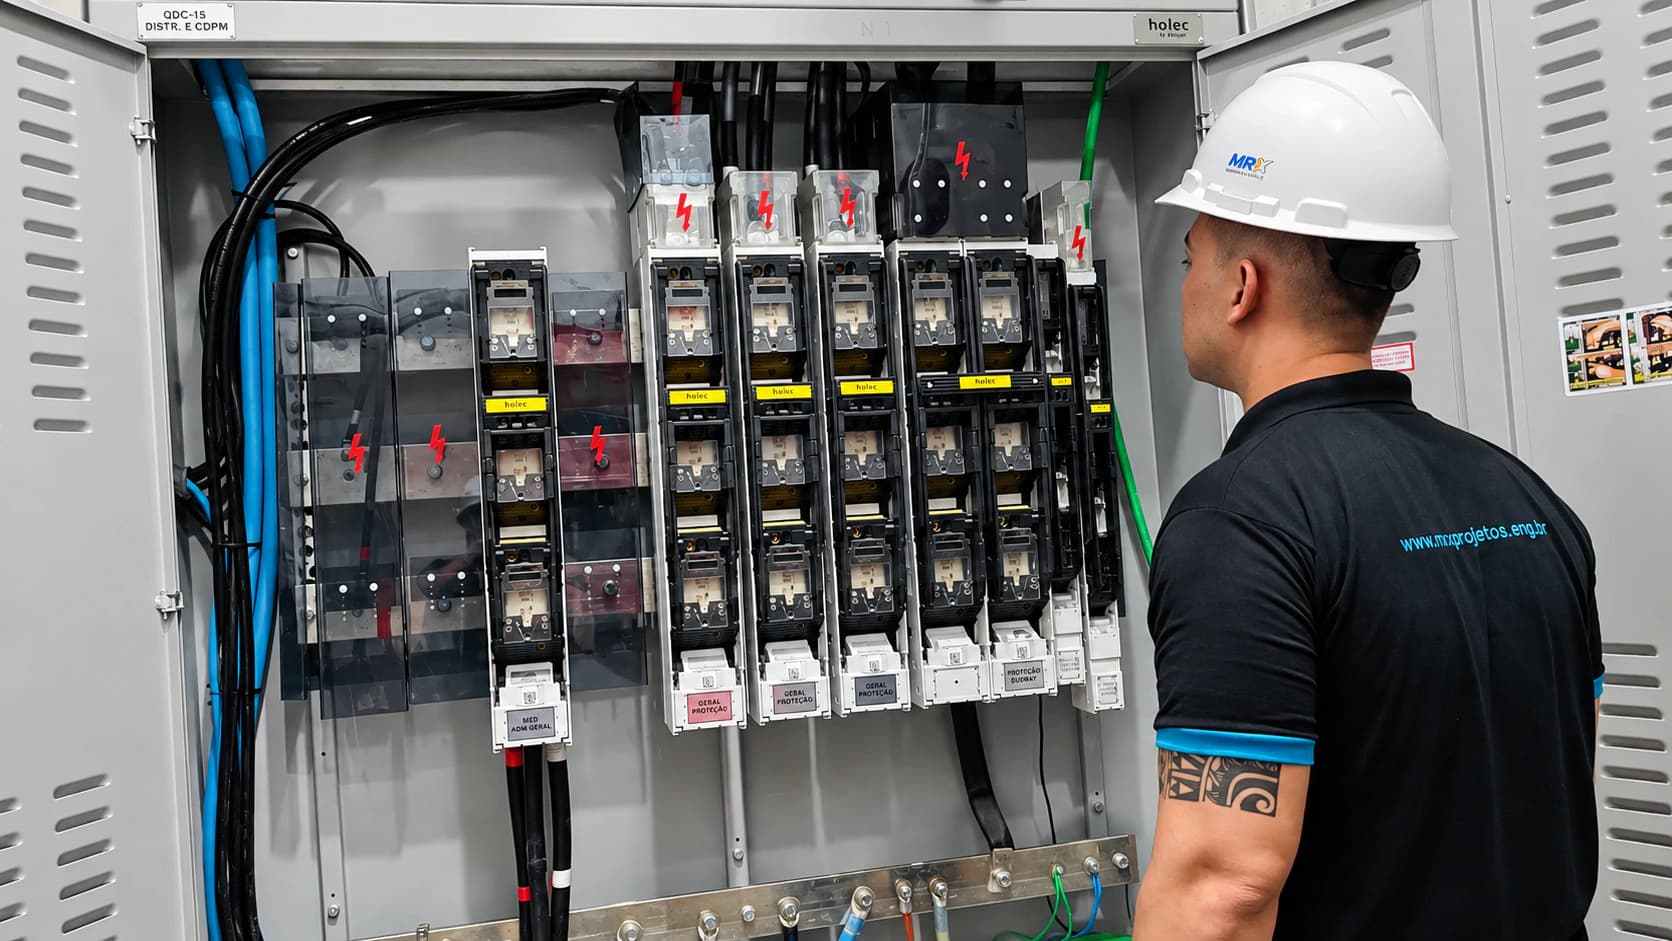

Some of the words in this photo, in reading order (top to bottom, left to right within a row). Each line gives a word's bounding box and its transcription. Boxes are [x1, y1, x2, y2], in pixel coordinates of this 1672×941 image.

[163, 10, 206, 20] QDC-15
[145, 22, 181, 32] DISTR.
[185, 22, 192, 32] E
[195, 22, 228, 32] CDPM
[1148, 17, 1189, 31] holec
[975, 377, 996, 385] holec
[686, 392, 708, 400] holec
[504, 400, 528, 409] holec
